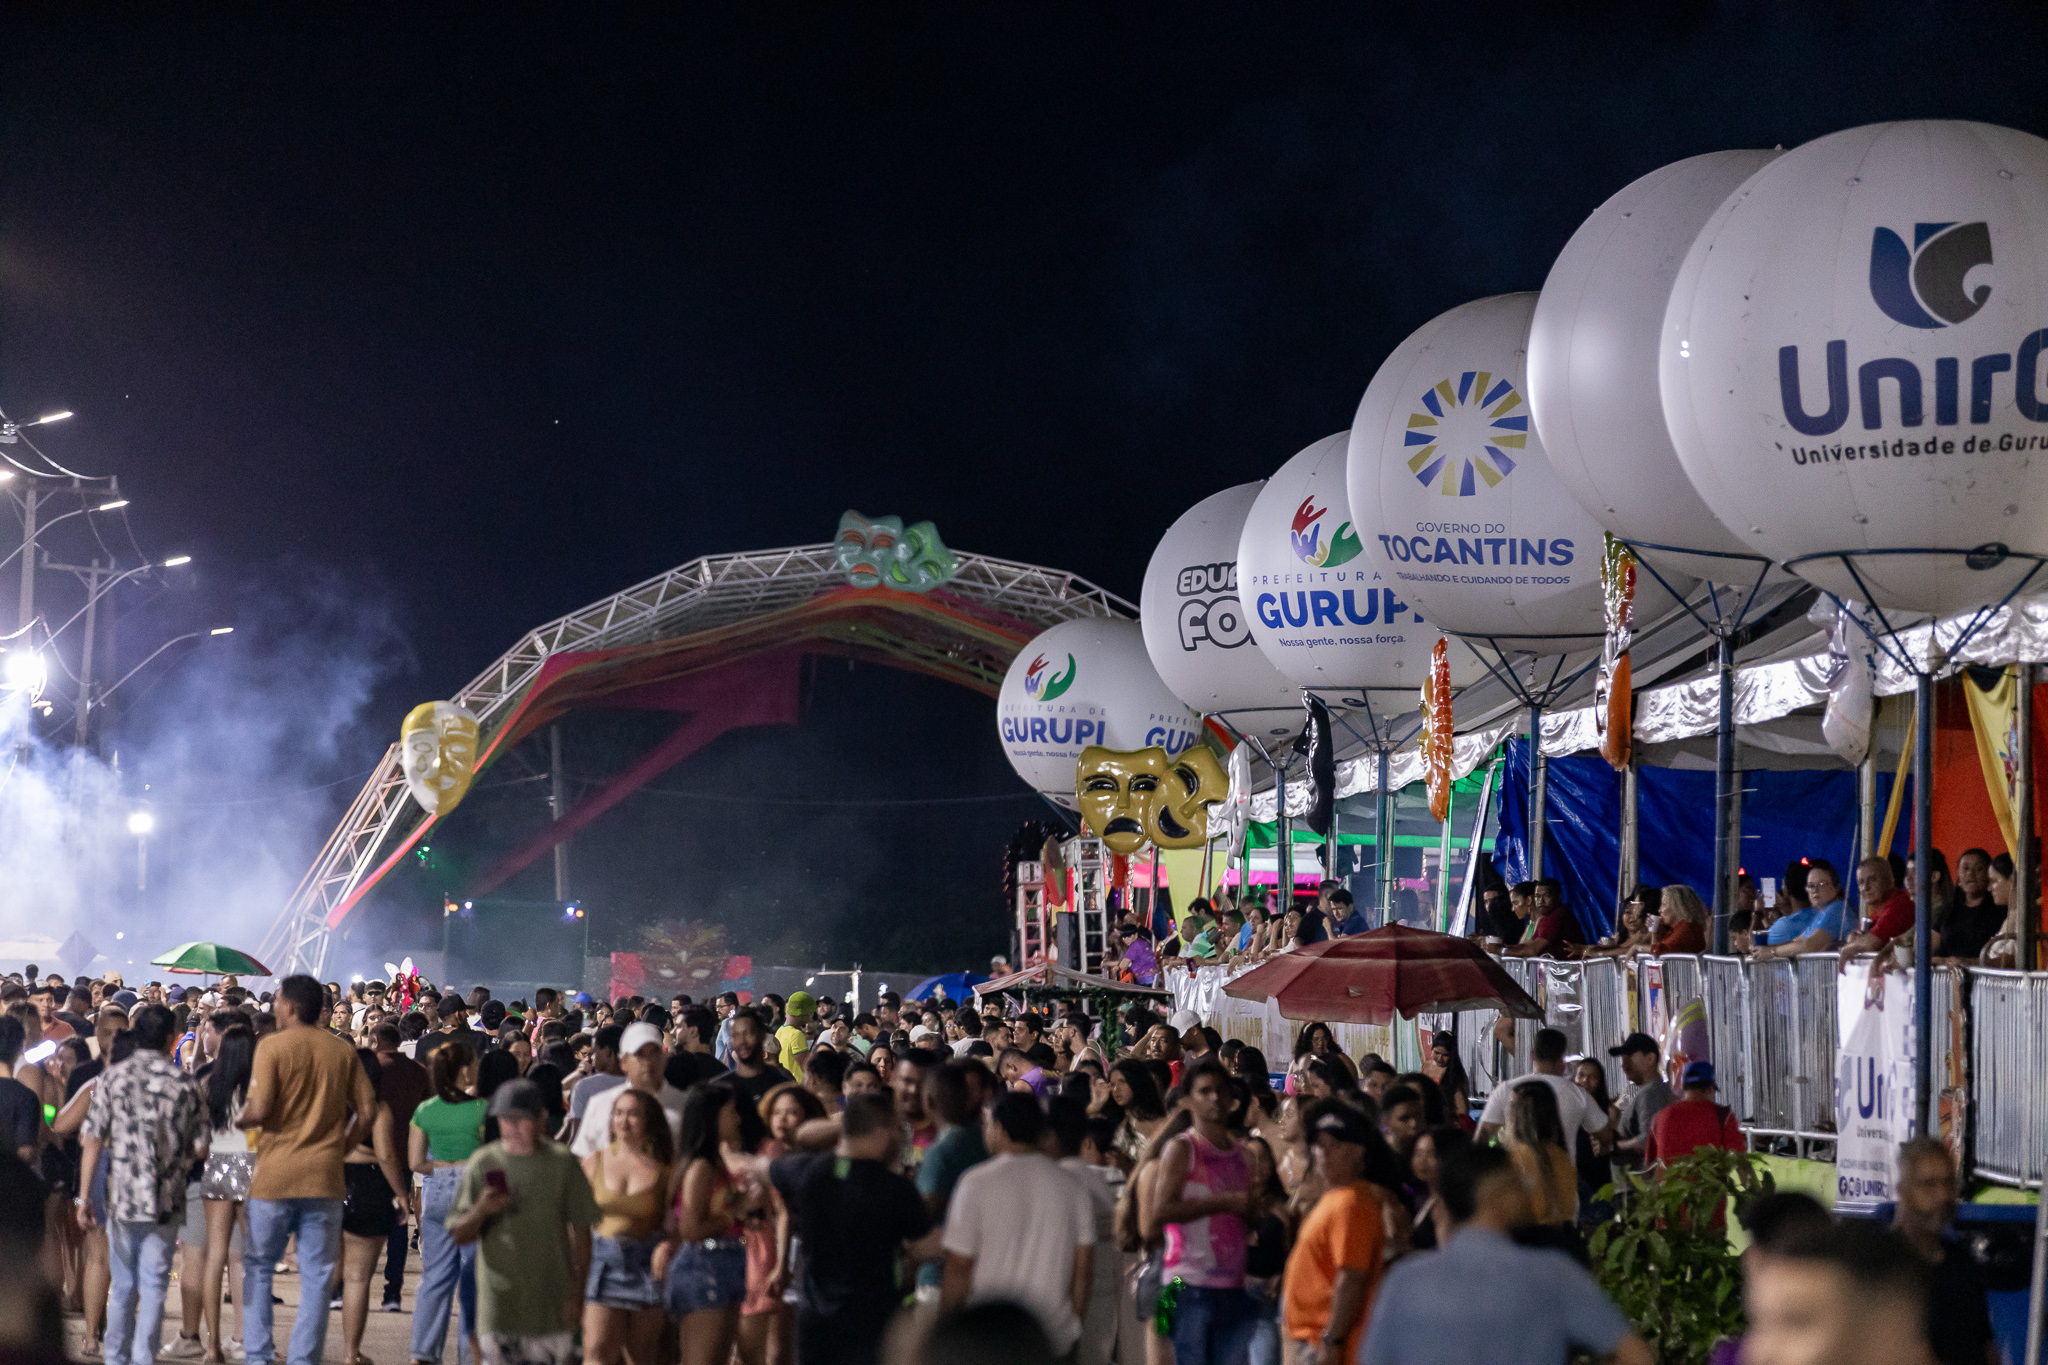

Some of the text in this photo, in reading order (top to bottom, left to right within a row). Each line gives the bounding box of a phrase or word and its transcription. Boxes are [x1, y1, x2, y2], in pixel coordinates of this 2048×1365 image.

[1792, 436, 1954, 465] Universidade
[1962, 436, 1992, 454] de
[1416, 522, 1505, 534] GOVERNO DO
[1378, 534, 1575, 566] TOCANTINS
[1253, 571, 1382, 586] PREFEITURA
[1396, 572, 1571, 584] TRABALHANDO E CUIDANDO DE TODOS
[1279, 633, 1406, 649] Nossa gente, nossa força.
[1089, 707, 1106, 716] DE
[1002, 717, 1105, 745] GURUPI
